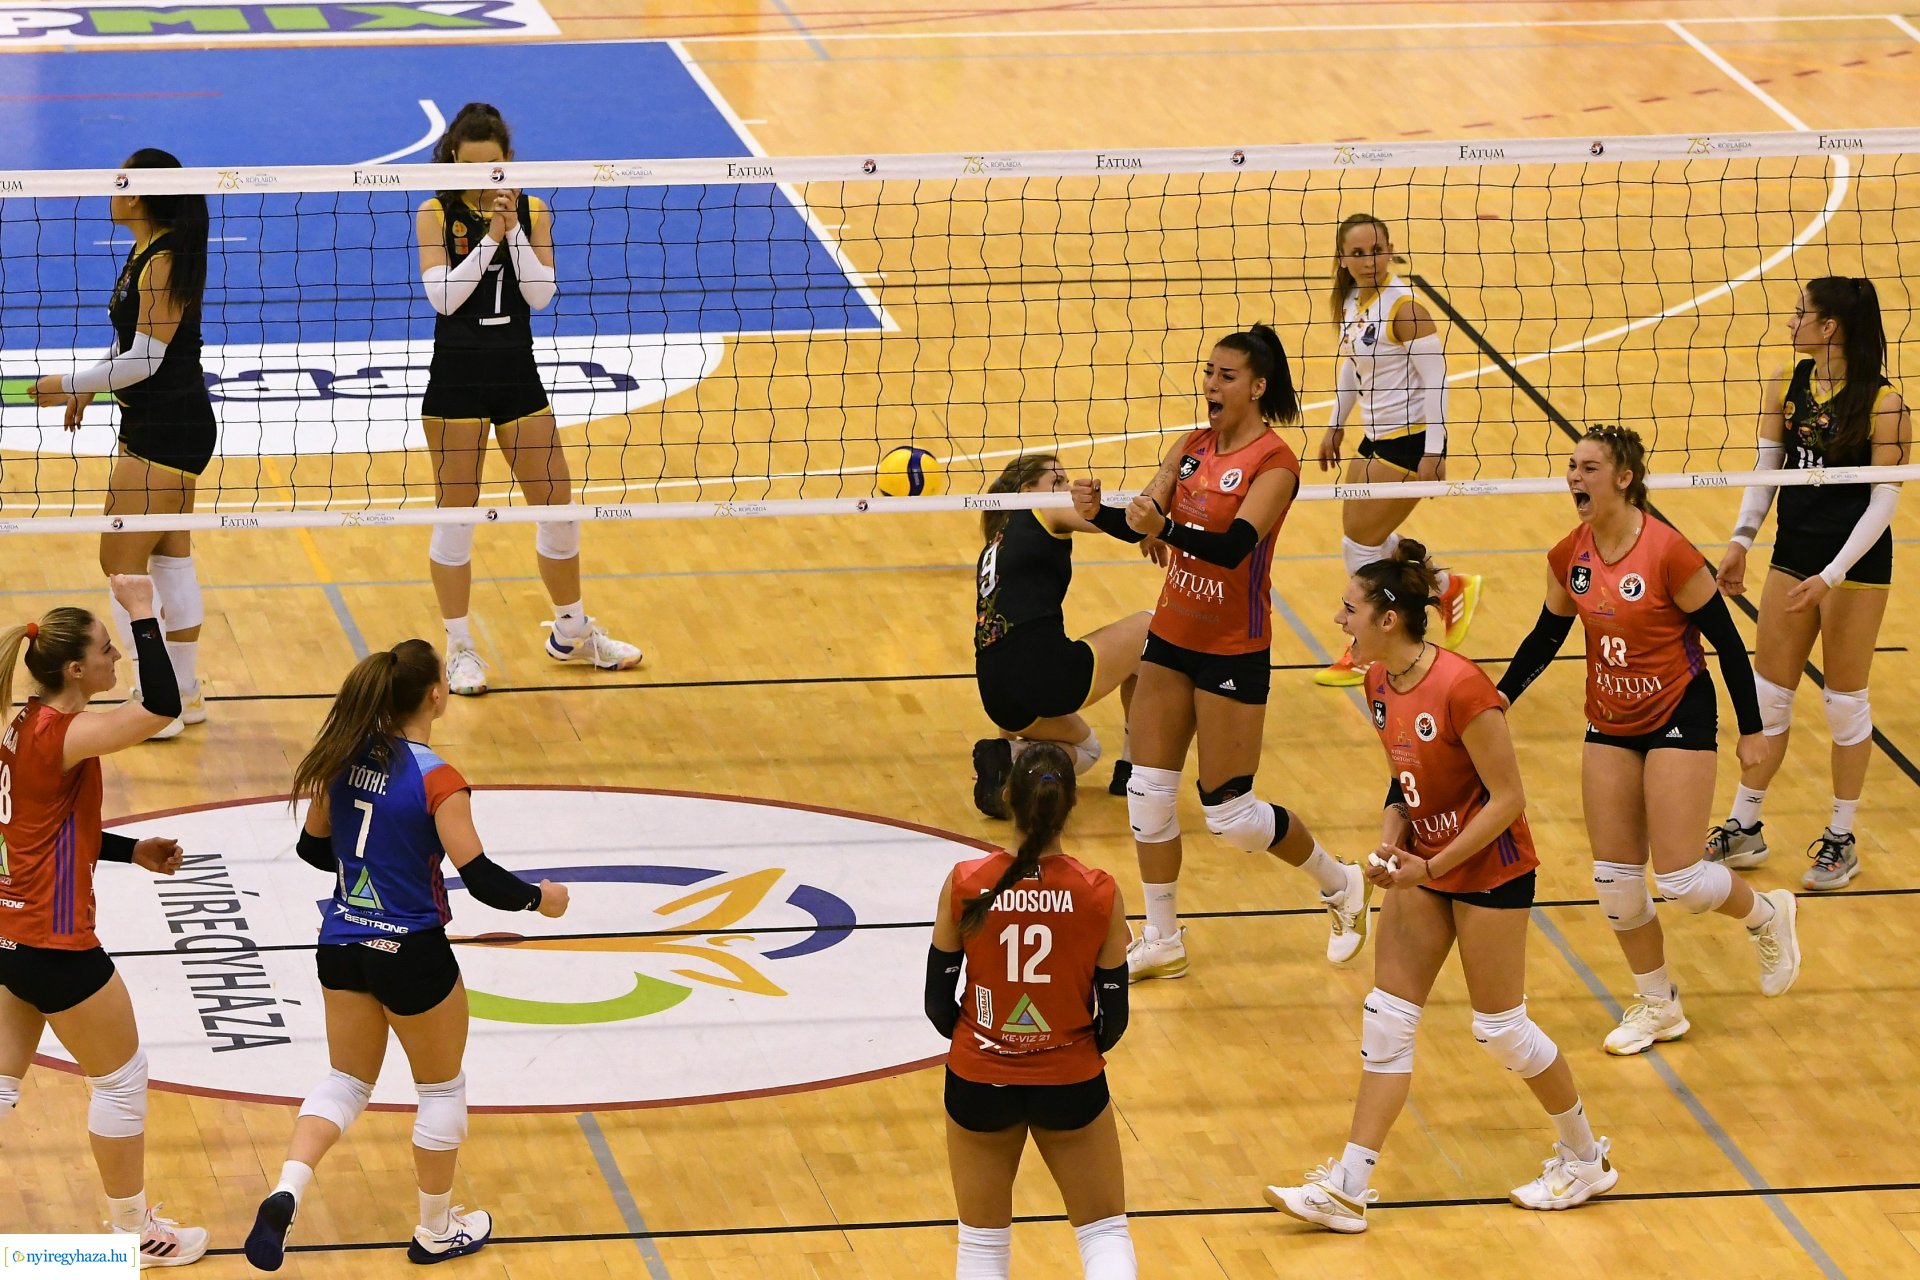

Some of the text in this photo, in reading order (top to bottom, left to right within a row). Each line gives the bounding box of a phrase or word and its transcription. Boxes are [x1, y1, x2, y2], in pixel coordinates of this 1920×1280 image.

[1818, 135, 1864, 149] FATUM
[1459, 145, 1506, 159] FATUM
[1095, 154, 1143, 169] FATUM
[726, 163, 774, 177] FATUM
[353, 171, 401, 185] FATUM
[1691, 475, 1728, 487] FATUM
[1334, 487, 1371, 499] FATUM
[963, 497, 1001, 509] FATUM
[594, 506, 632, 518] FATUM
[220, 515, 259, 527] FATUM
[980, 542, 998, 598] 9
[1600, 635, 1628, 667] 13
[1400, 770, 1421, 808] 3
[354, 799, 373, 859] 7
[344, 912, 409, 934] BESTRONG
[154, 853, 302, 1053] NYÍREGYHÁZA
[999, 923, 1053, 984] 12
[1001, 1032, 1051, 1043] KE-VIZ 21
